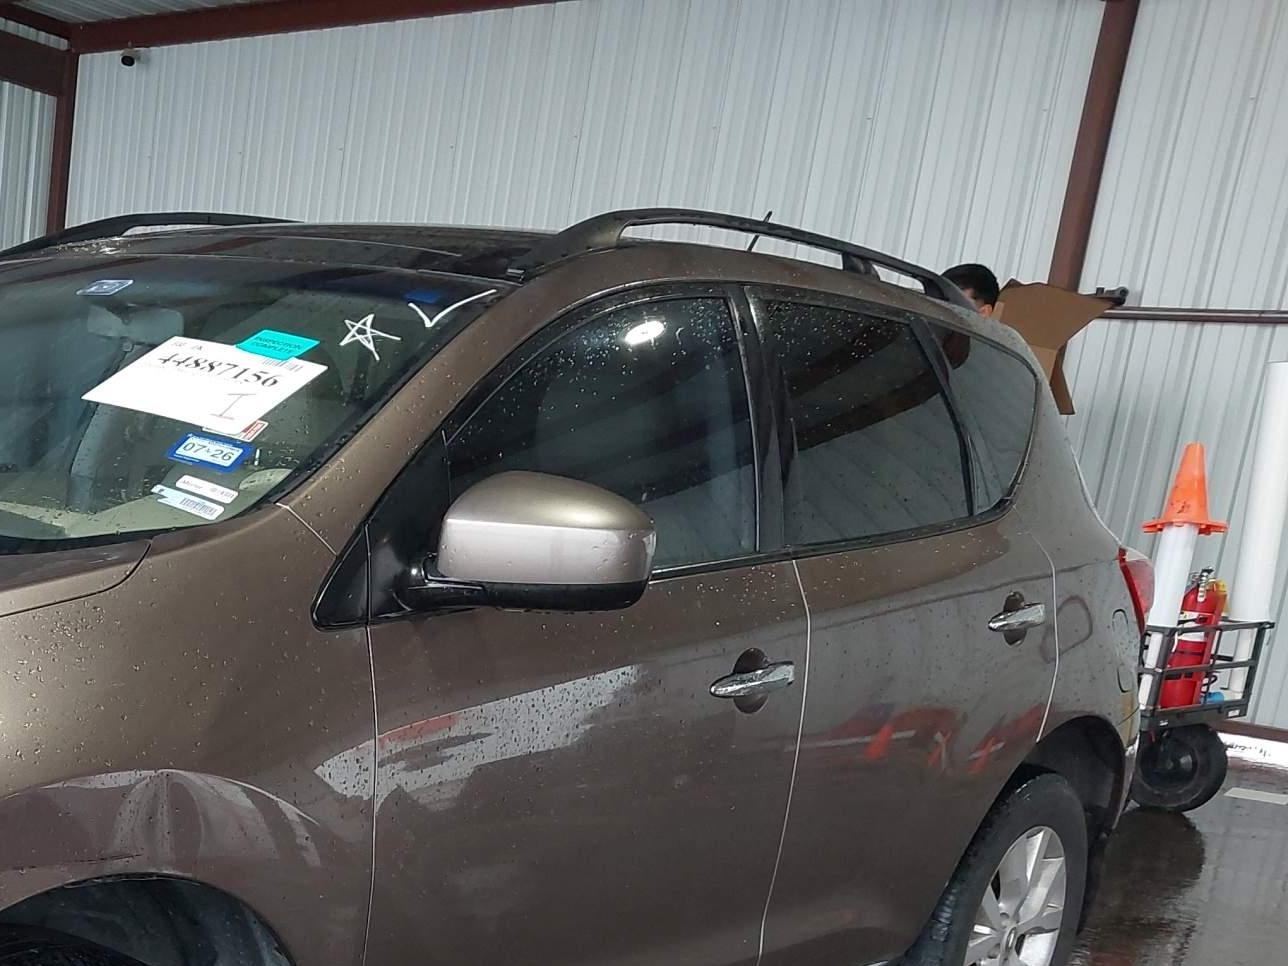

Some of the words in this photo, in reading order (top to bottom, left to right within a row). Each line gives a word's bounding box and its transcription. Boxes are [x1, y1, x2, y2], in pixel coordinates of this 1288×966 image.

[158, 353, 281, 387] 44887156
[183, 442, 207, 454] 07
[210, 449, 235, 461] 26
